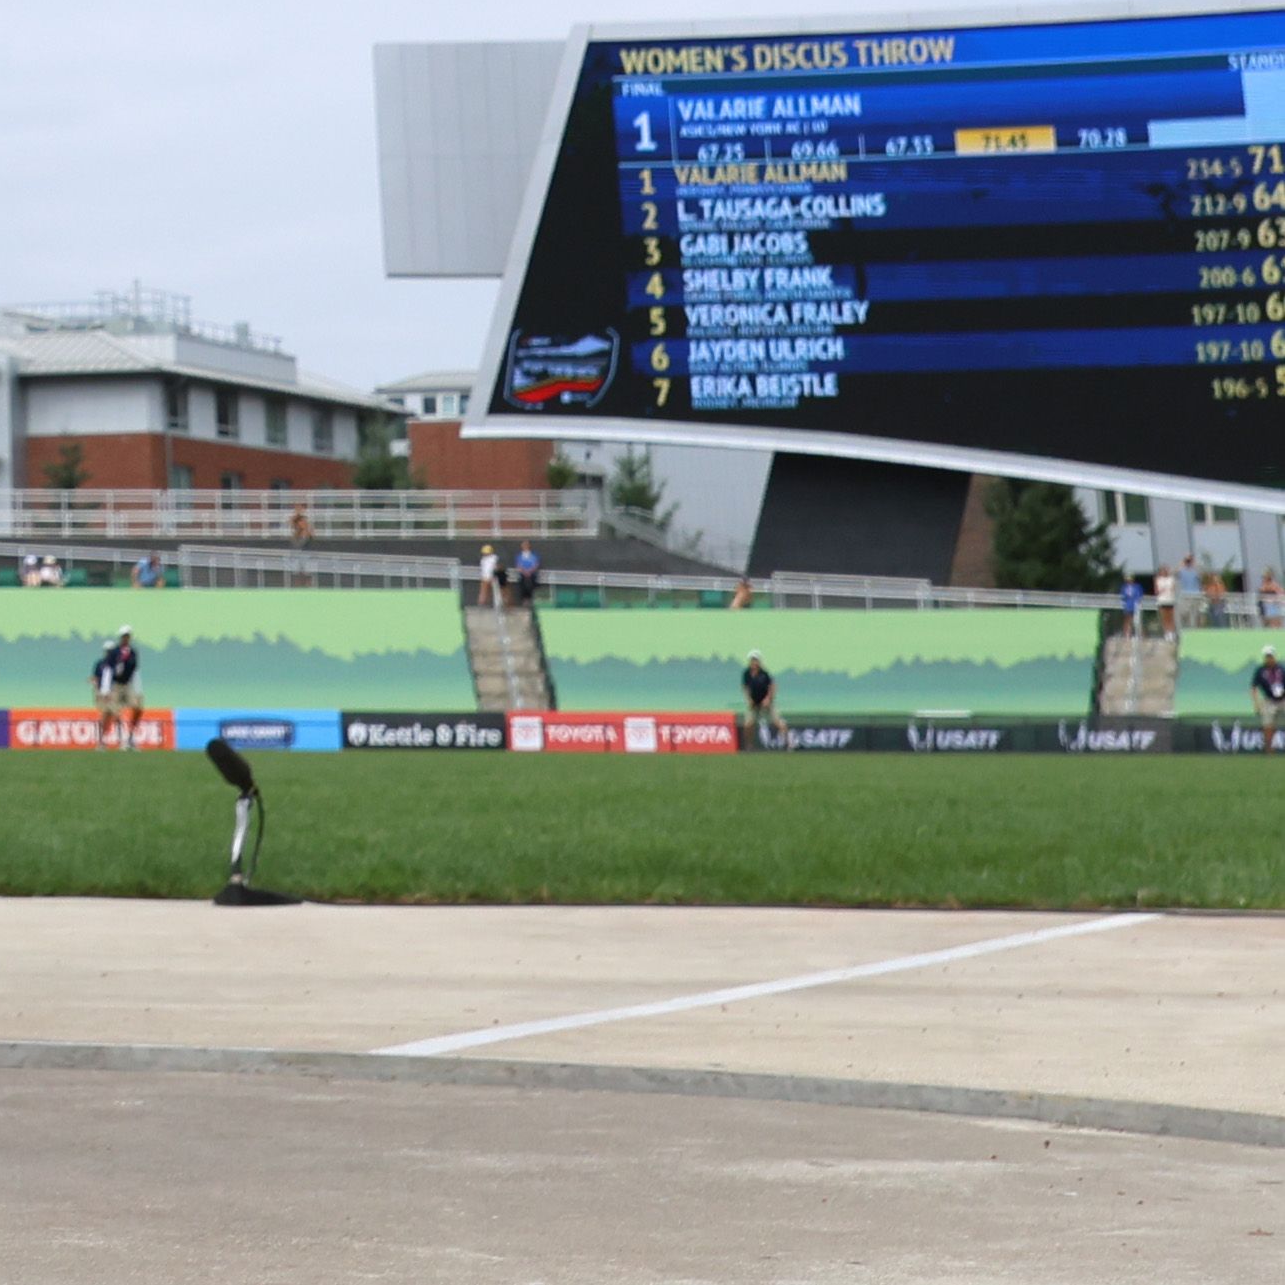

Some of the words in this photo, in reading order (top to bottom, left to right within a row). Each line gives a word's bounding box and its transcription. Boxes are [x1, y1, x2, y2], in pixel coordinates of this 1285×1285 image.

[619, 43, 747, 75] WOMEN'S
[753, 40, 848, 69] DISCUS
[854, 36, 955, 66] THROW
[622, 82, 664, 97] FINAL
[633, 111, 657, 152] 1
[678, 97, 766, 122] VALARIE
[773, 93, 862, 118] ALLMAN
[639, 168, 656, 195] 1
[673, 163, 759, 185] VALARIE
[763, 160, 848, 183] ALLMAN
[641, 201, 659, 230] 2
[699, 192, 887, 220] TAUSAGA-COLLINS
[1191, 192, 1247, 216] 212-9
[643, 237, 661, 266] 3
[680, 233, 728, 257] GABI
[732, 231, 809, 256] JACOBS
[1194, 228, 1251, 252] 207-9
[645, 272, 665, 300] 4
[683, 268, 760, 293] SHELBY
[764, 265, 834, 291] FRANK
[649, 306, 667, 336] 5
[684, 302, 789, 327] VERONICA
[791, 300, 870, 325] FRALEY
[1192, 302, 1261, 327] 197-10
[650, 342, 670, 372] 6
[688, 338, 766, 363] JAYDEN
[769, 336, 845, 361] ULRICH
[1195, 338, 1265, 363] 197-10
[652, 377, 671, 408] 7
[690, 373, 754, 398] ERIKA
[756, 372, 839, 397] BEISTLE
[1212, 377, 1269, 399] 196-5
[368, 722, 434, 747] Kettle
[454, 722, 502, 747] Fire
[546, 724, 618, 744] TOYOTA
[659, 725, 731, 745] TOYOTA
[936, 729, 1001, 750] USATF
[1088, 730, 1157, 751] USATF
